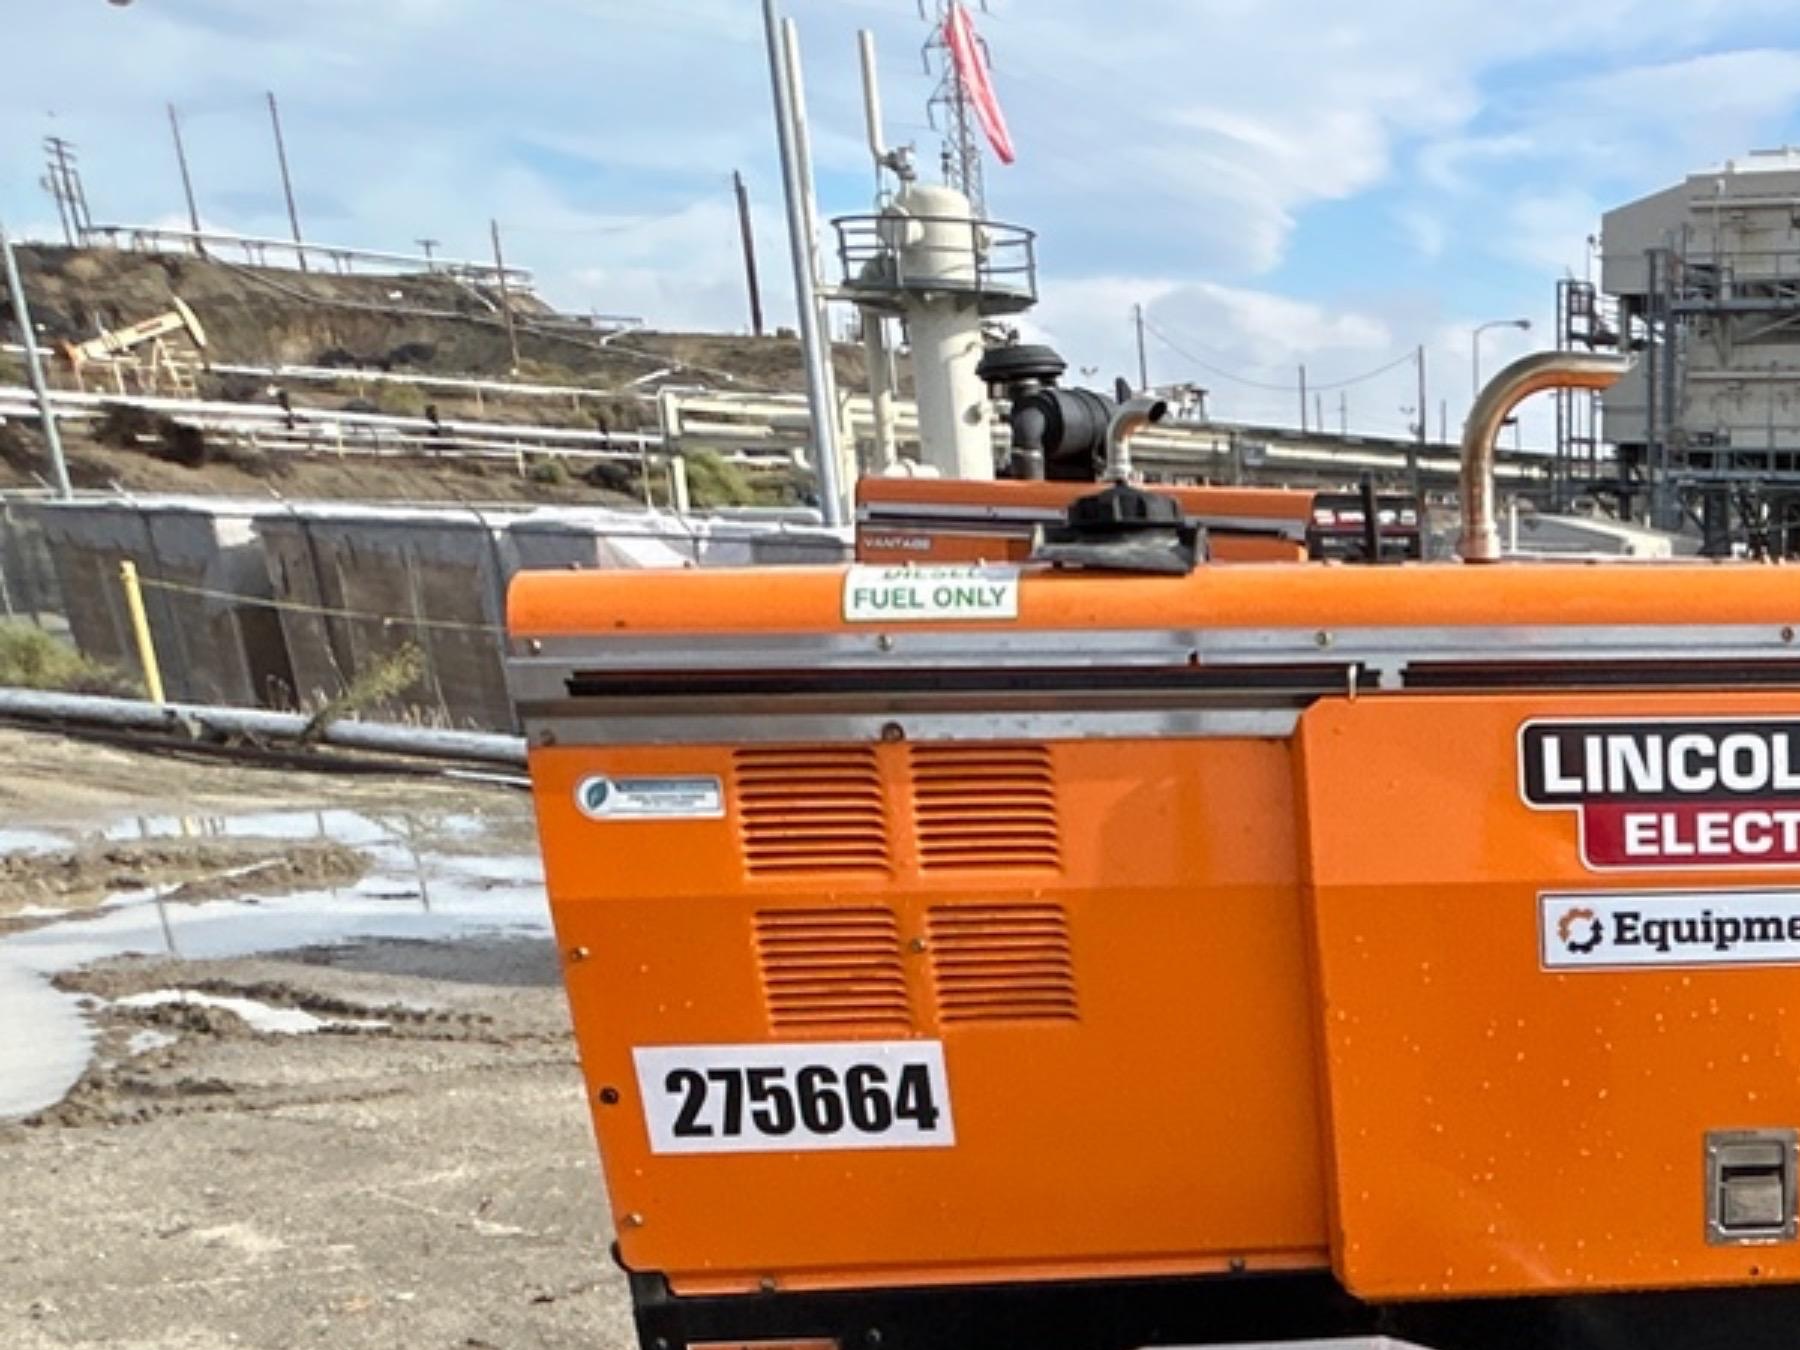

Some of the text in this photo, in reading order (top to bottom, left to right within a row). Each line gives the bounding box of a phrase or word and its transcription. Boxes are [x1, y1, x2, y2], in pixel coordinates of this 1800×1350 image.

[854, 585, 1006, 609] FUEL ONLY
[665, 1064, 939, 1137] 275664
